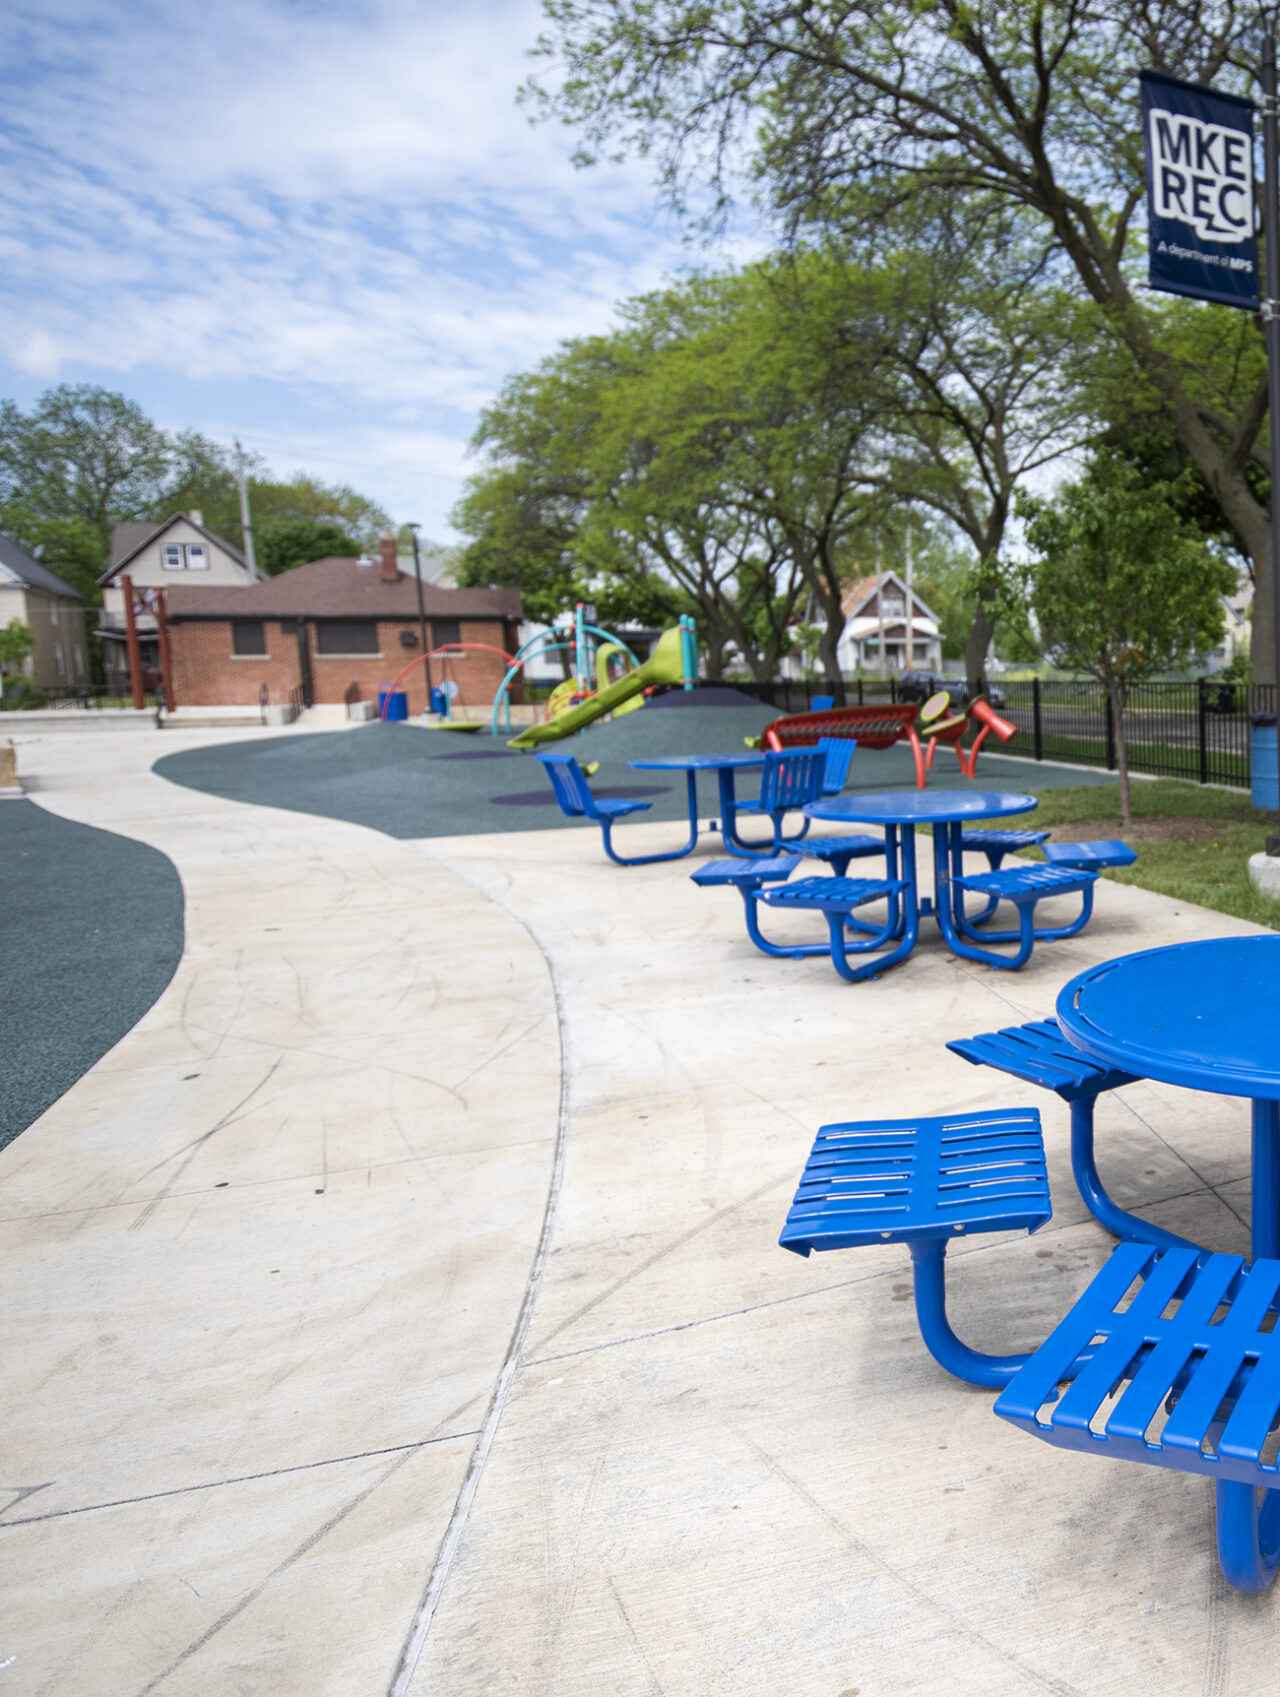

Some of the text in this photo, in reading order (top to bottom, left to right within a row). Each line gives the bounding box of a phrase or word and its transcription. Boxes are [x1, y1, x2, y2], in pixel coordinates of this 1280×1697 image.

[1156, 118, 1246, 181] MKE
[1161, 165, 1247, 233] REC
[1157, 240, 1167, 252] A
[1168, 242, 1219, 265] department
[1229, 257, 1253, 273] MPS
